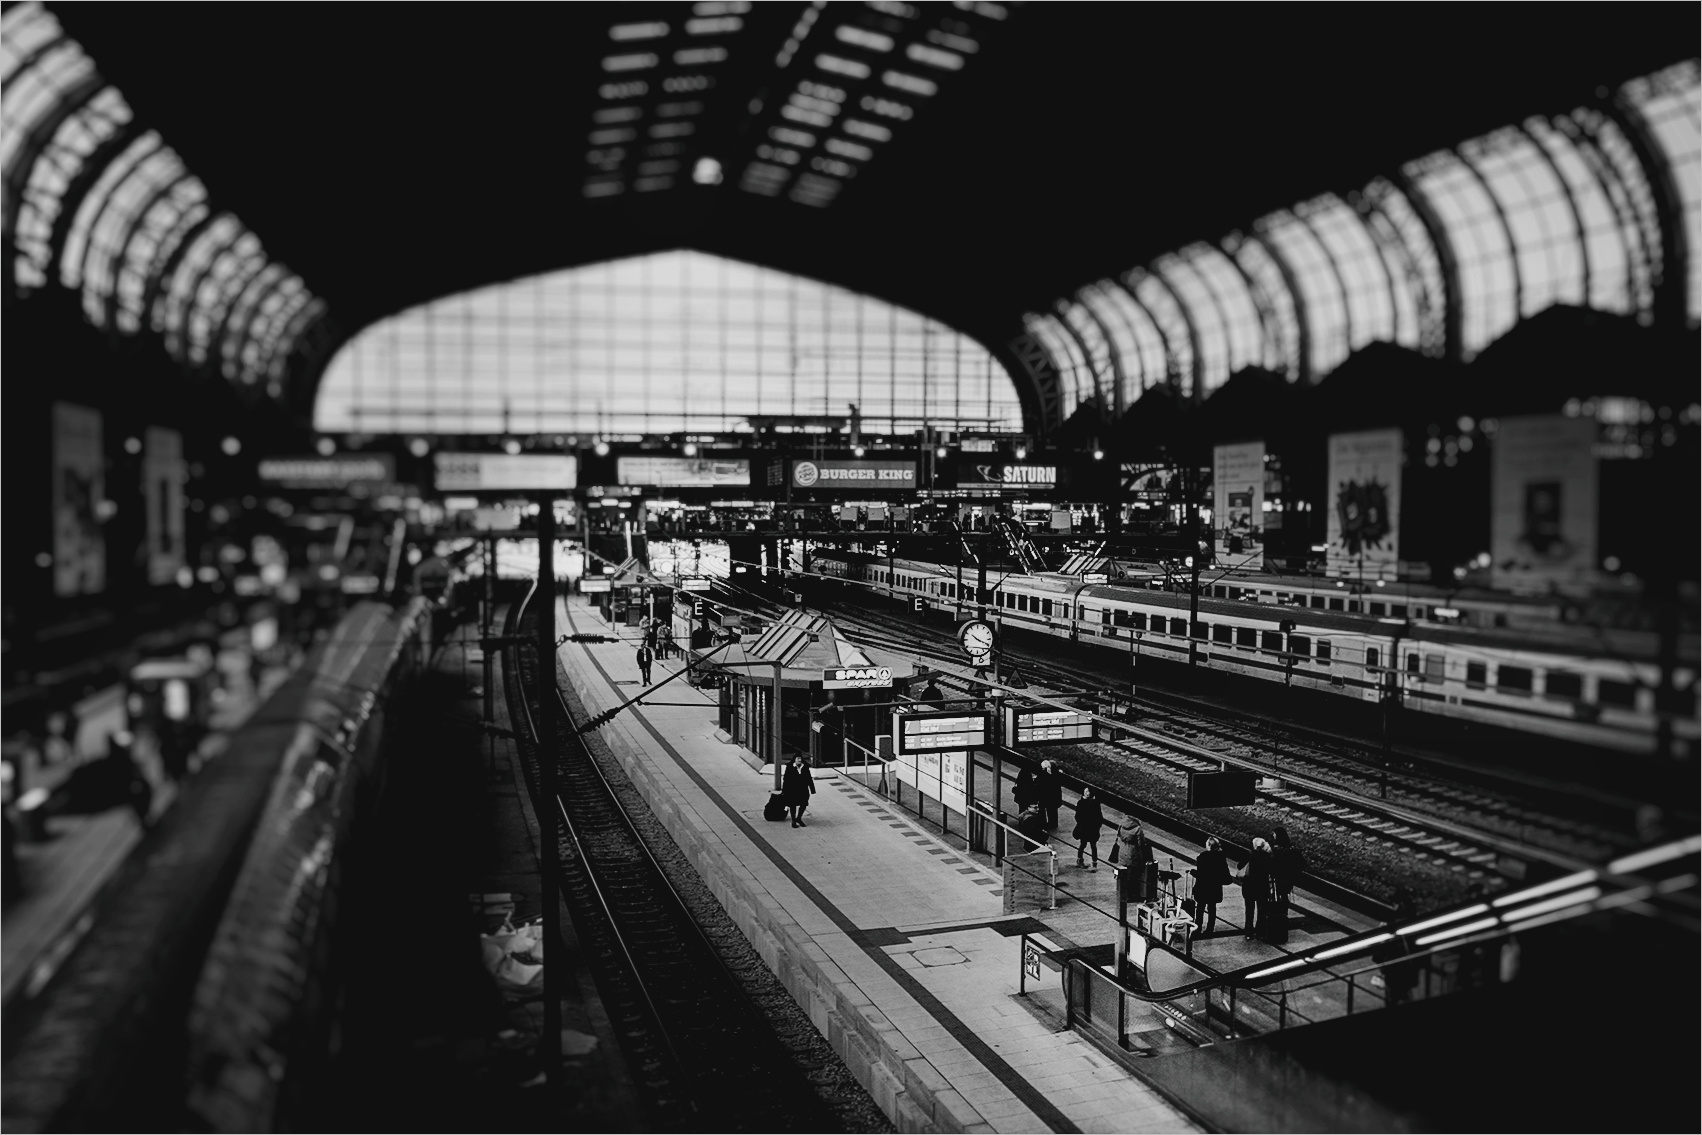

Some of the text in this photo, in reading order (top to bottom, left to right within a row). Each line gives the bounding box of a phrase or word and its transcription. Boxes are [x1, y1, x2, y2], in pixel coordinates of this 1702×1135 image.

[820, 468, 876, 480] BURGER
[878, 469, 914, 480] KING
[1003, 465, 1057, 483] SATURN
[694, 601, 703, 616] E
[914, 597, 923, 611] E
[835, 669, 877, 680] SPAR
